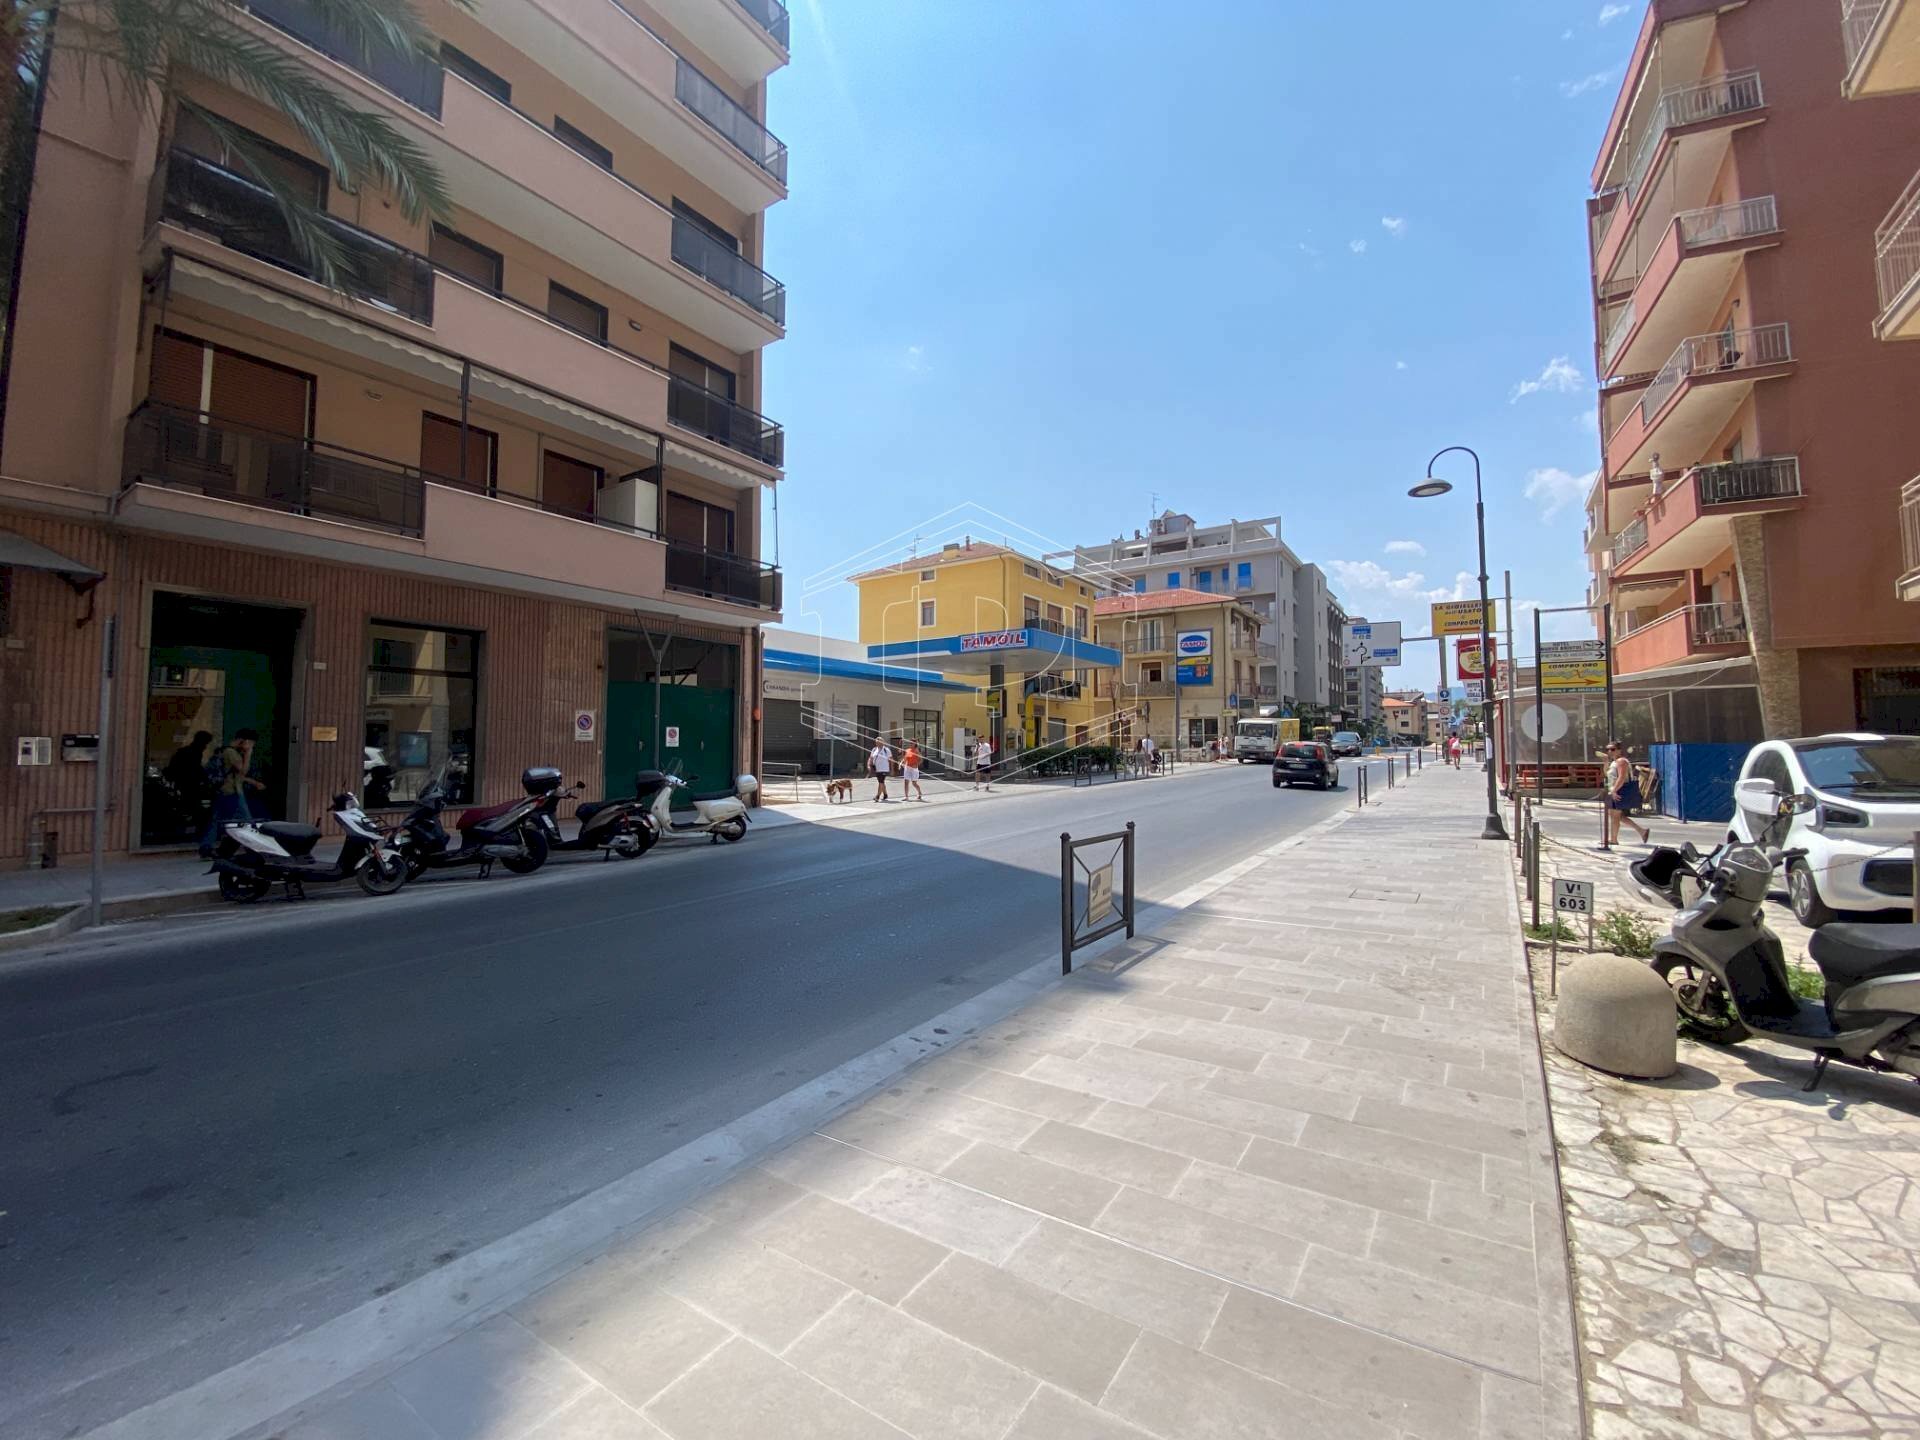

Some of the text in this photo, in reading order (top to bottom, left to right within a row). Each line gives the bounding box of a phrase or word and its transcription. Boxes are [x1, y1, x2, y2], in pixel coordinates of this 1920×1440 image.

[963, 633, 1025, 649] TAMOIL
[1180, 640, 1208, 648] TAMOIL
[1559, 897, 1586, 911] 603
